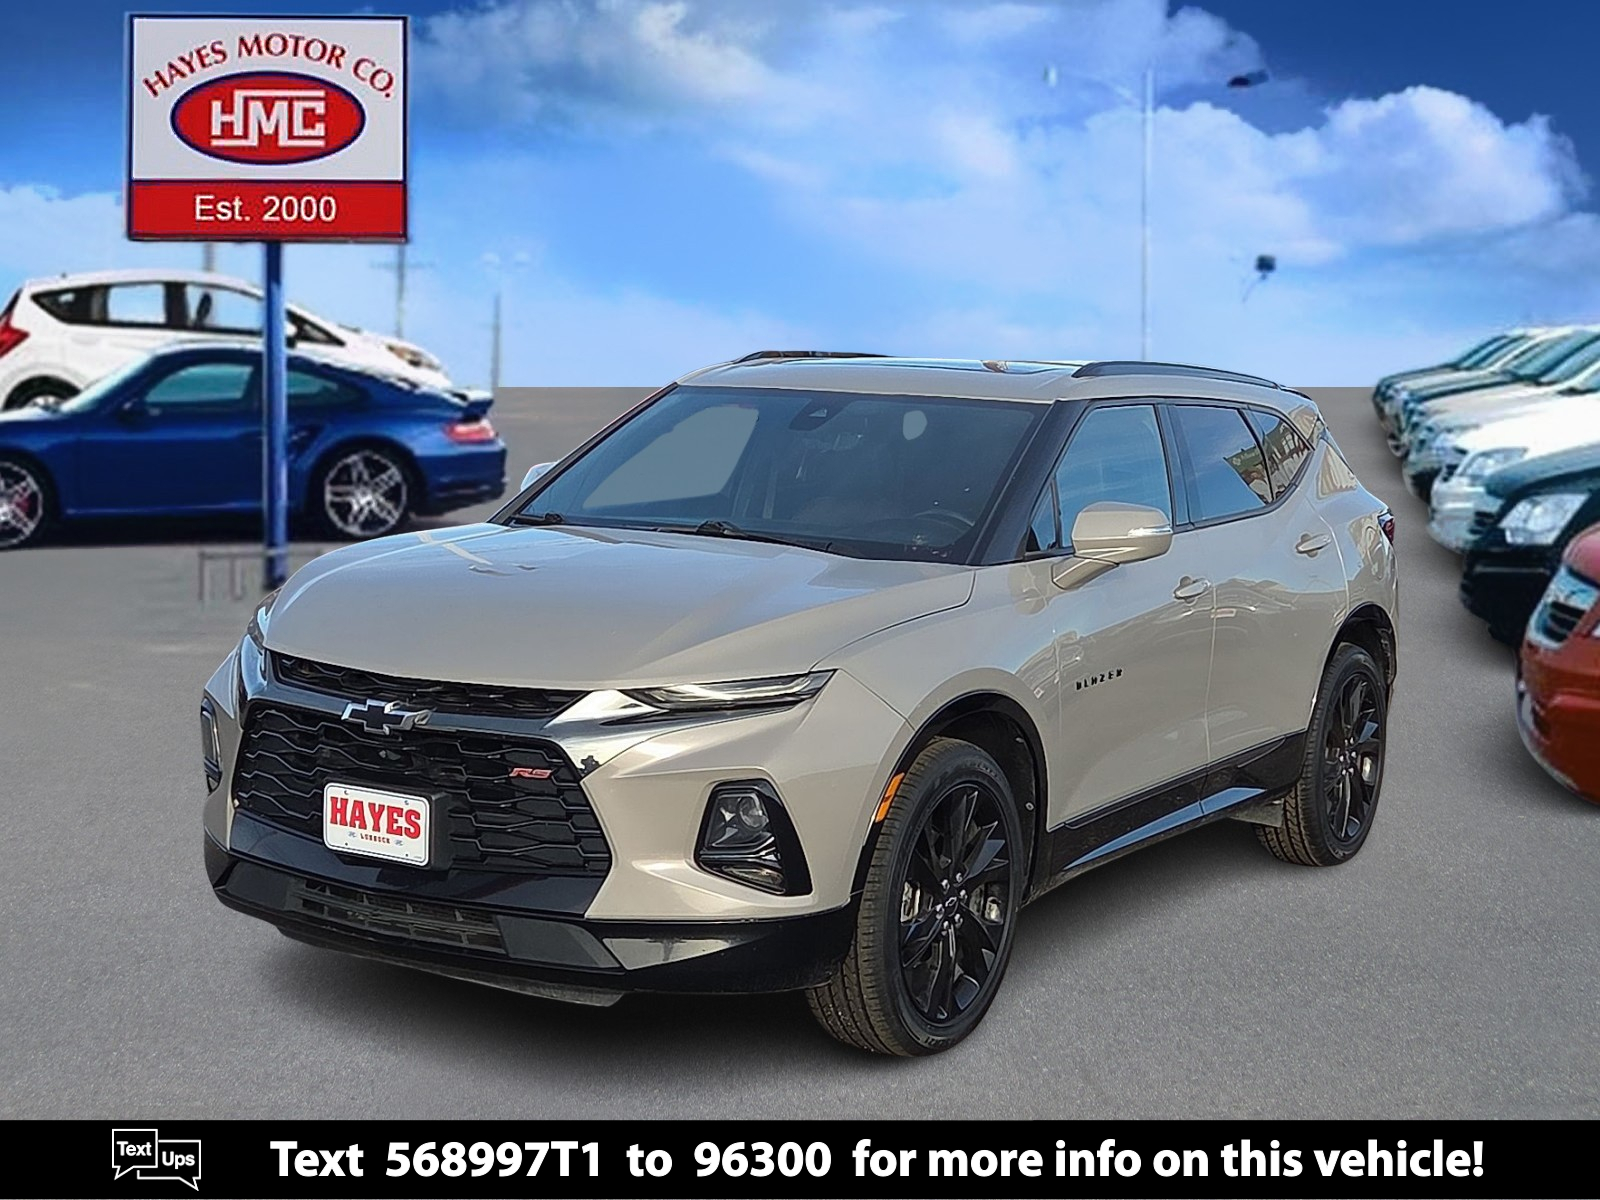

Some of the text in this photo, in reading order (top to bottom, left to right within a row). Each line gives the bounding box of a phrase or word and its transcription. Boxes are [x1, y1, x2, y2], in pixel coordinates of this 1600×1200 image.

[142, 33, 395, 98] HAYES MOTOR CO.
[210, 89, 326, 147] HMC
[194, 195, 337, 221] Est. 2000
[509, 767, 552, 779] RS
[330, 796, 421, 839] HAYES
